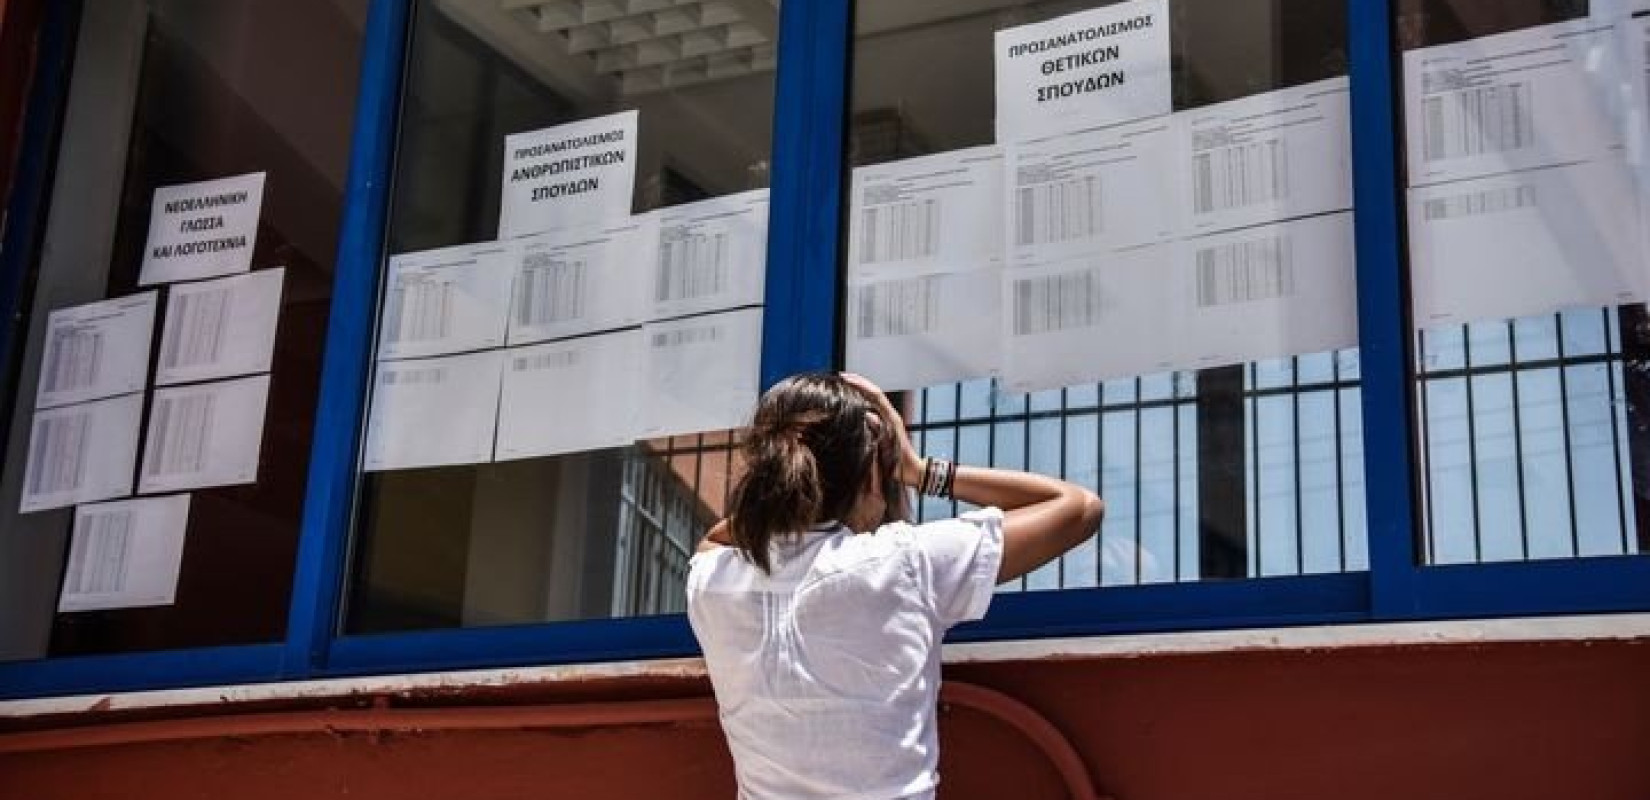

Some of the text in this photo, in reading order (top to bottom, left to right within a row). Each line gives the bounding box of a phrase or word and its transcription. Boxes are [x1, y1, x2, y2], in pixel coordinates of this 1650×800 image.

[1008, 15, 1153, 58] ΠΡΟΣΑΝΑΤΟΛΙΣΜΟΣ
[1041, 45, 1119, 76] ΘΕΤΙΚΩΝ
[1037, 70, 1124, 101] ΣΠΟΥΔΩΝ
[513, 130, 624, 158] ΠΡΟΣΑΝΑΤΟΛΙΣΜΟΣ
[511, 150, 624, 182] ΑΝΘΡΩΠΙΣΤΙΚΩΝ
[164, 190, 248, 214] ΝΕΟΕΛΛΗΝΙΚΗ
[531, 176, 599, 202] ΣΠΟΥΔΩΝ
[180, 216, 224, 234] ΓΛΩΣΣΑ
[153, 236, 246, 259] ΚΑΙ ΛΟΓΟΤΕΧΝΙΑ
